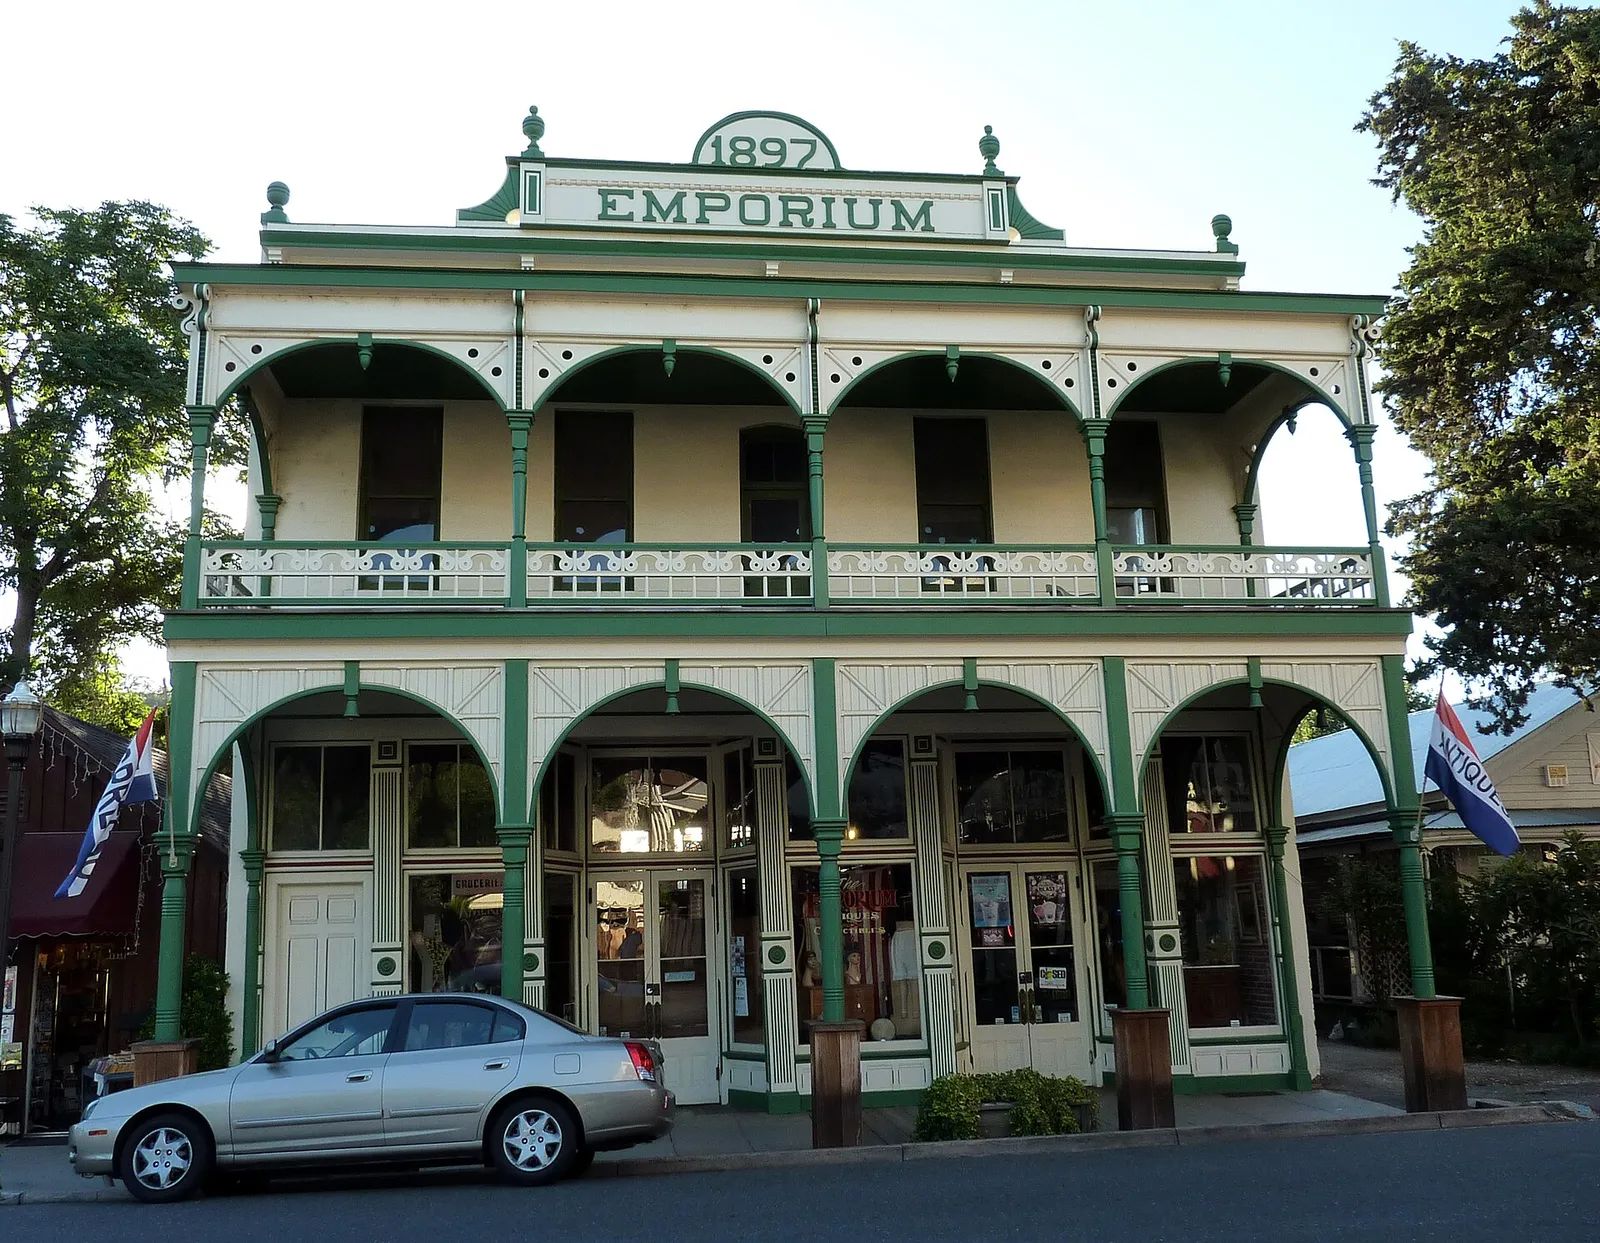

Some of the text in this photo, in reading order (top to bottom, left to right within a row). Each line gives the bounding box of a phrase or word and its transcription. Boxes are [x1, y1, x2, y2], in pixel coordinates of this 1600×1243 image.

[711, 135, 817, 169] 1897
[597, 188, 935, 232] EMPORIUM
[455, 879, 502, 889] GROCERIE
[800, 889, 898, 919] EORIUM
